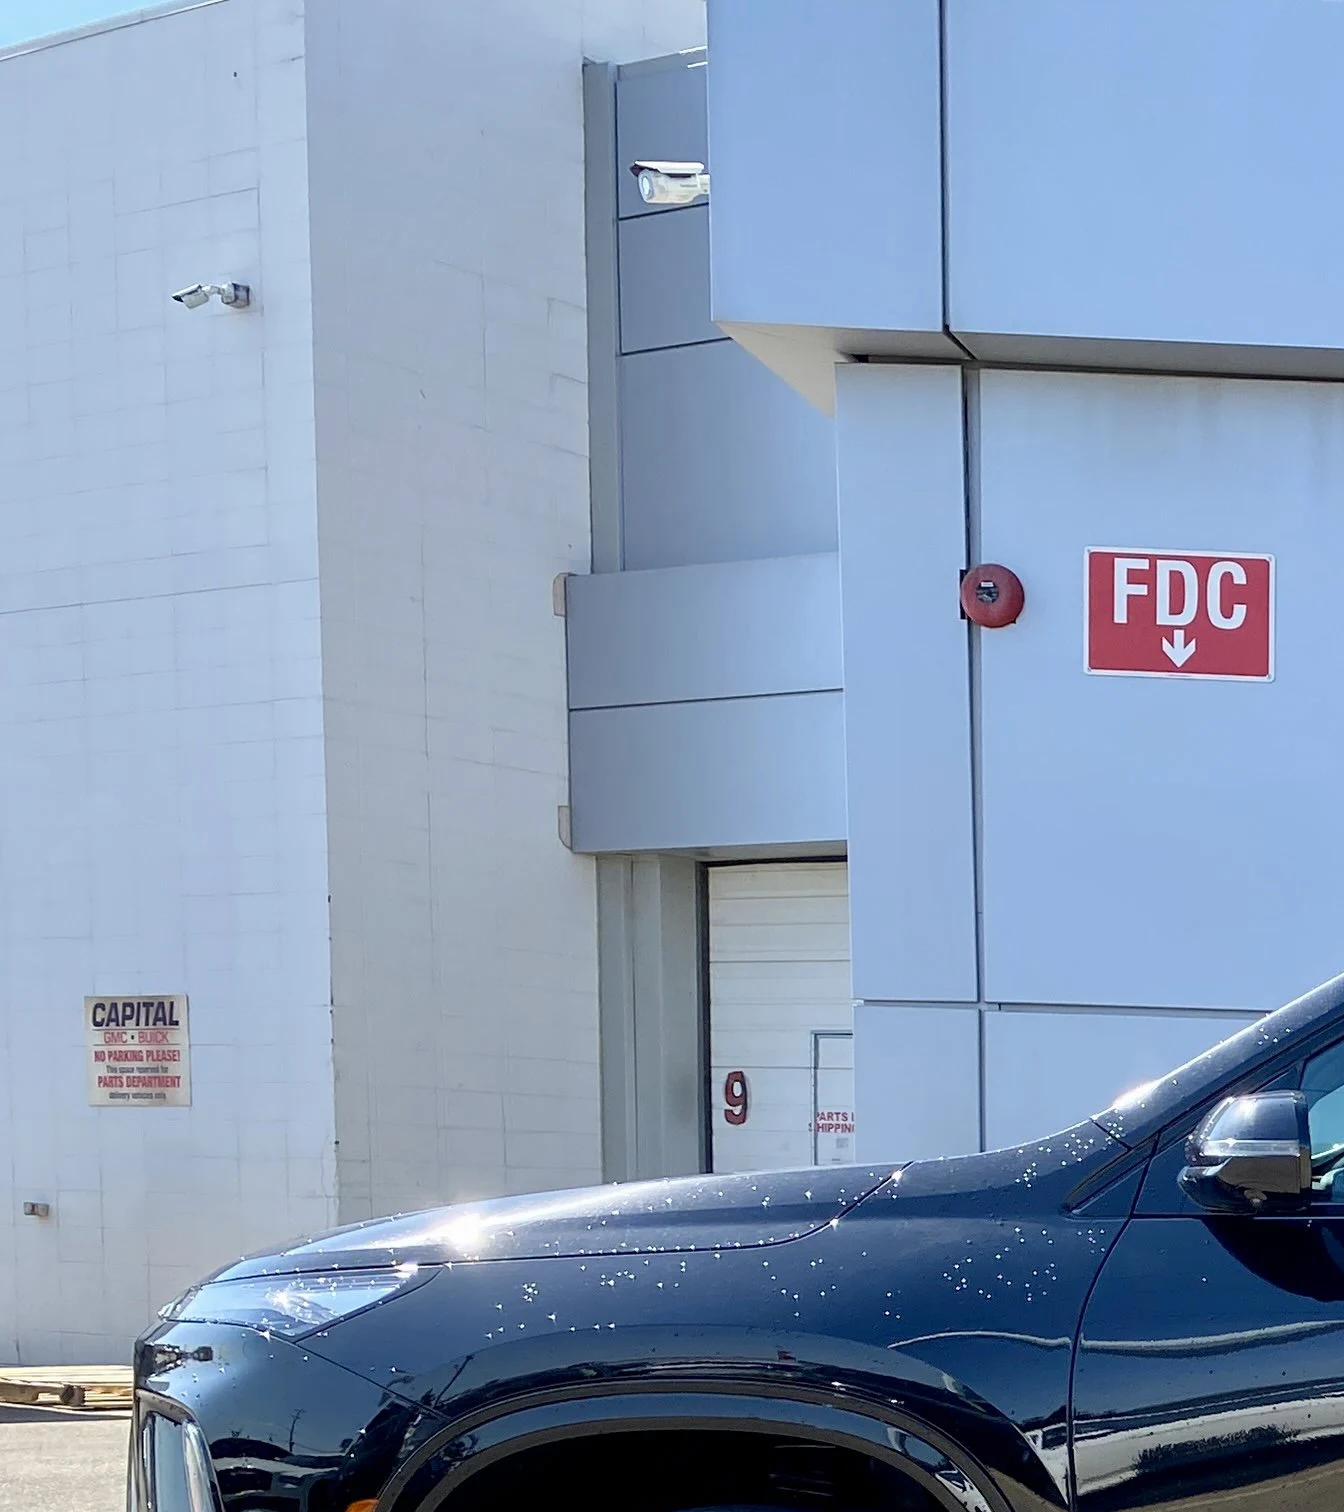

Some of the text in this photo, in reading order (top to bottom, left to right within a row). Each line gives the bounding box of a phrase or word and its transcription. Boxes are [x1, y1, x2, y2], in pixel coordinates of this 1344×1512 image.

[1112, 556, 1247, 631] FDC
[92, 1001, 180, 1027] CAPITAL
[103, 1031, 170, 1044] GMC BUICK
[94, 1049, 181, 1062] NO PARKING PLEASE!
[97, 1075, 182, 1088] PARTS DEPARTMENT
[724, 1070, 748, 1126] 9
